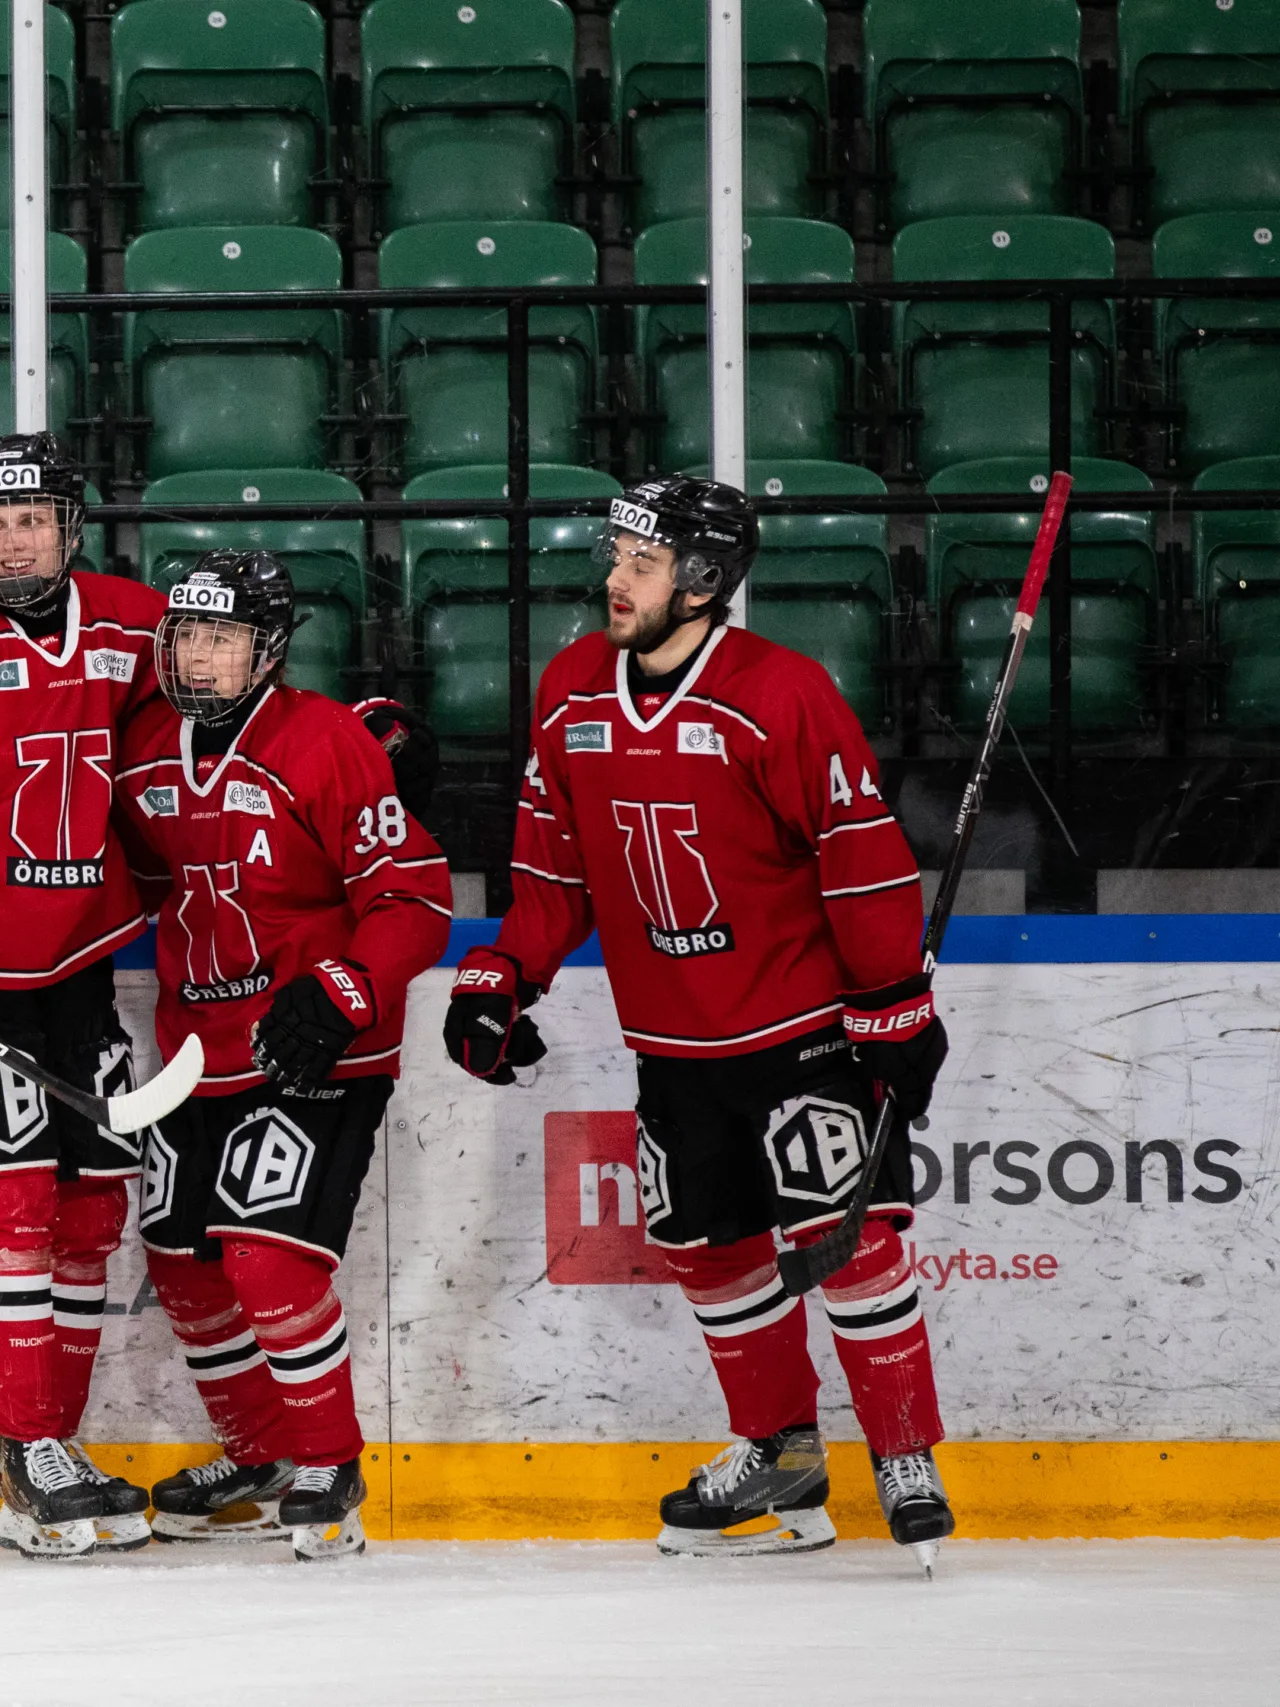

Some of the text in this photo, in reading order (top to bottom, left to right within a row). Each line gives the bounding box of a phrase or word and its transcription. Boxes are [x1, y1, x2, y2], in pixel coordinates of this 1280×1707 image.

[108, 654, 128, 667] nkey
[626, 748, 661, 756] BAUER
[830, 753, 883, 806] 44
[954, 783, 973, 834] BAUER
[354, 795, 407, 854] 38
[246, 829, 273, 867] A
[651, 926, 727, 955] ÖREBRO
[183, 975, 270, 1001] ÖREBRO
[313, 959, 367, 1011] UER
[843, 1002, 931, 1033] BAUER
[254, 1303, 294, 1318] BAUER
